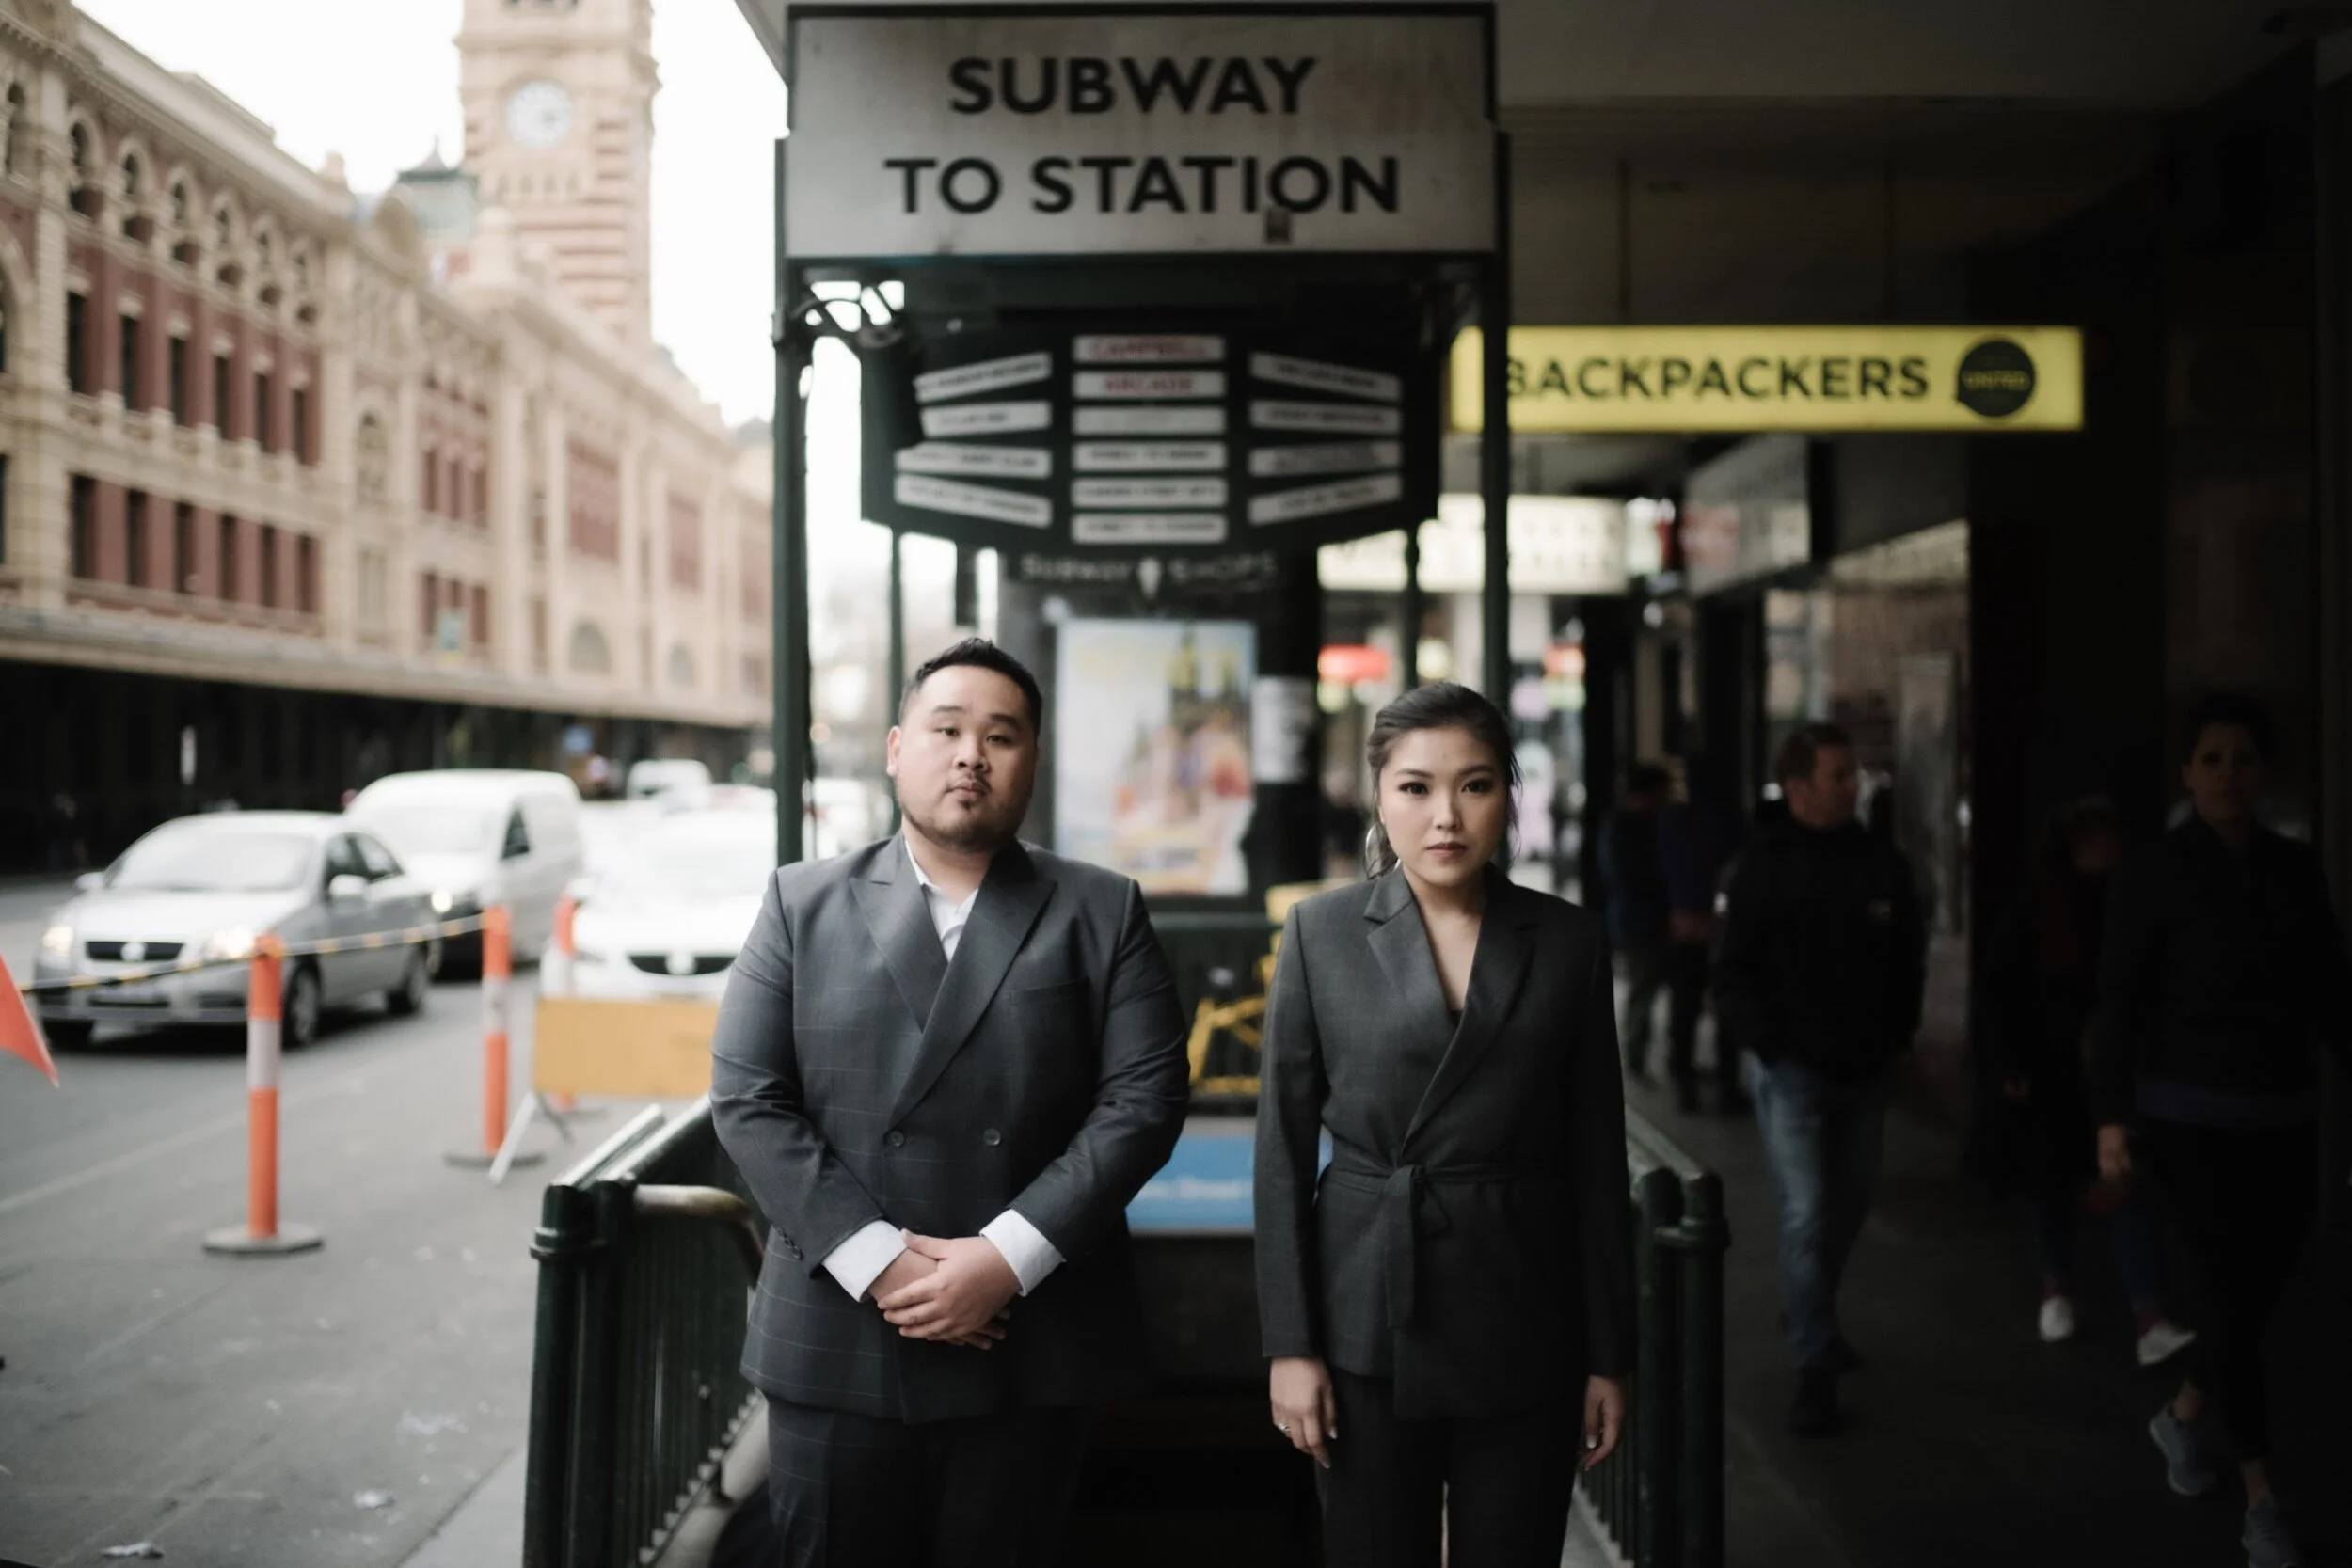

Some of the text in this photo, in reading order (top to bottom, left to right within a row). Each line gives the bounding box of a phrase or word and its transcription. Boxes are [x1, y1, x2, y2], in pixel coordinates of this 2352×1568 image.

[948, 56, 1318, 115] SUBWAY
[884, 156, 1400, 215] TO STATION
[1507, 357, 1929, 398] BACKPACKERS
